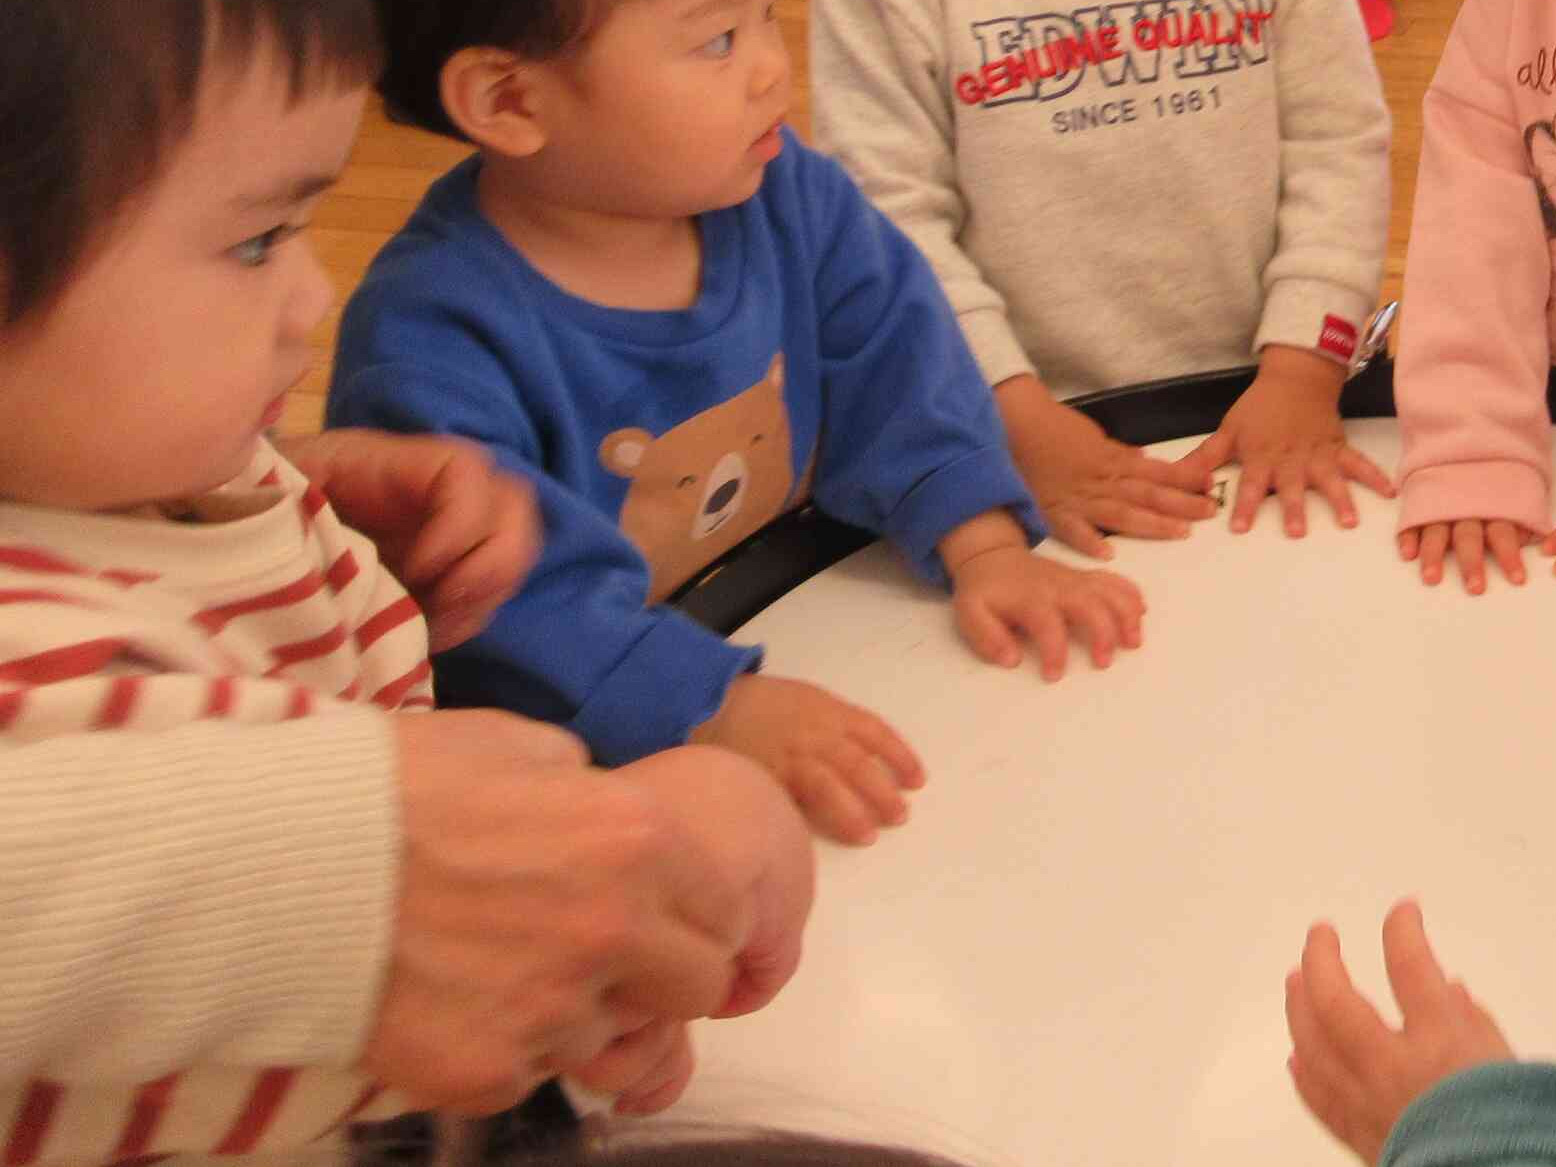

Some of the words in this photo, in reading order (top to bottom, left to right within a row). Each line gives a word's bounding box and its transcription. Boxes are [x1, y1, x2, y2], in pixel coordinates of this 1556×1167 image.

[955, 25, 1127, 105] GENUINE
[1132, 10, 1273, 51] QUALIT
[1051, 98, 1137, 134] SINCE
